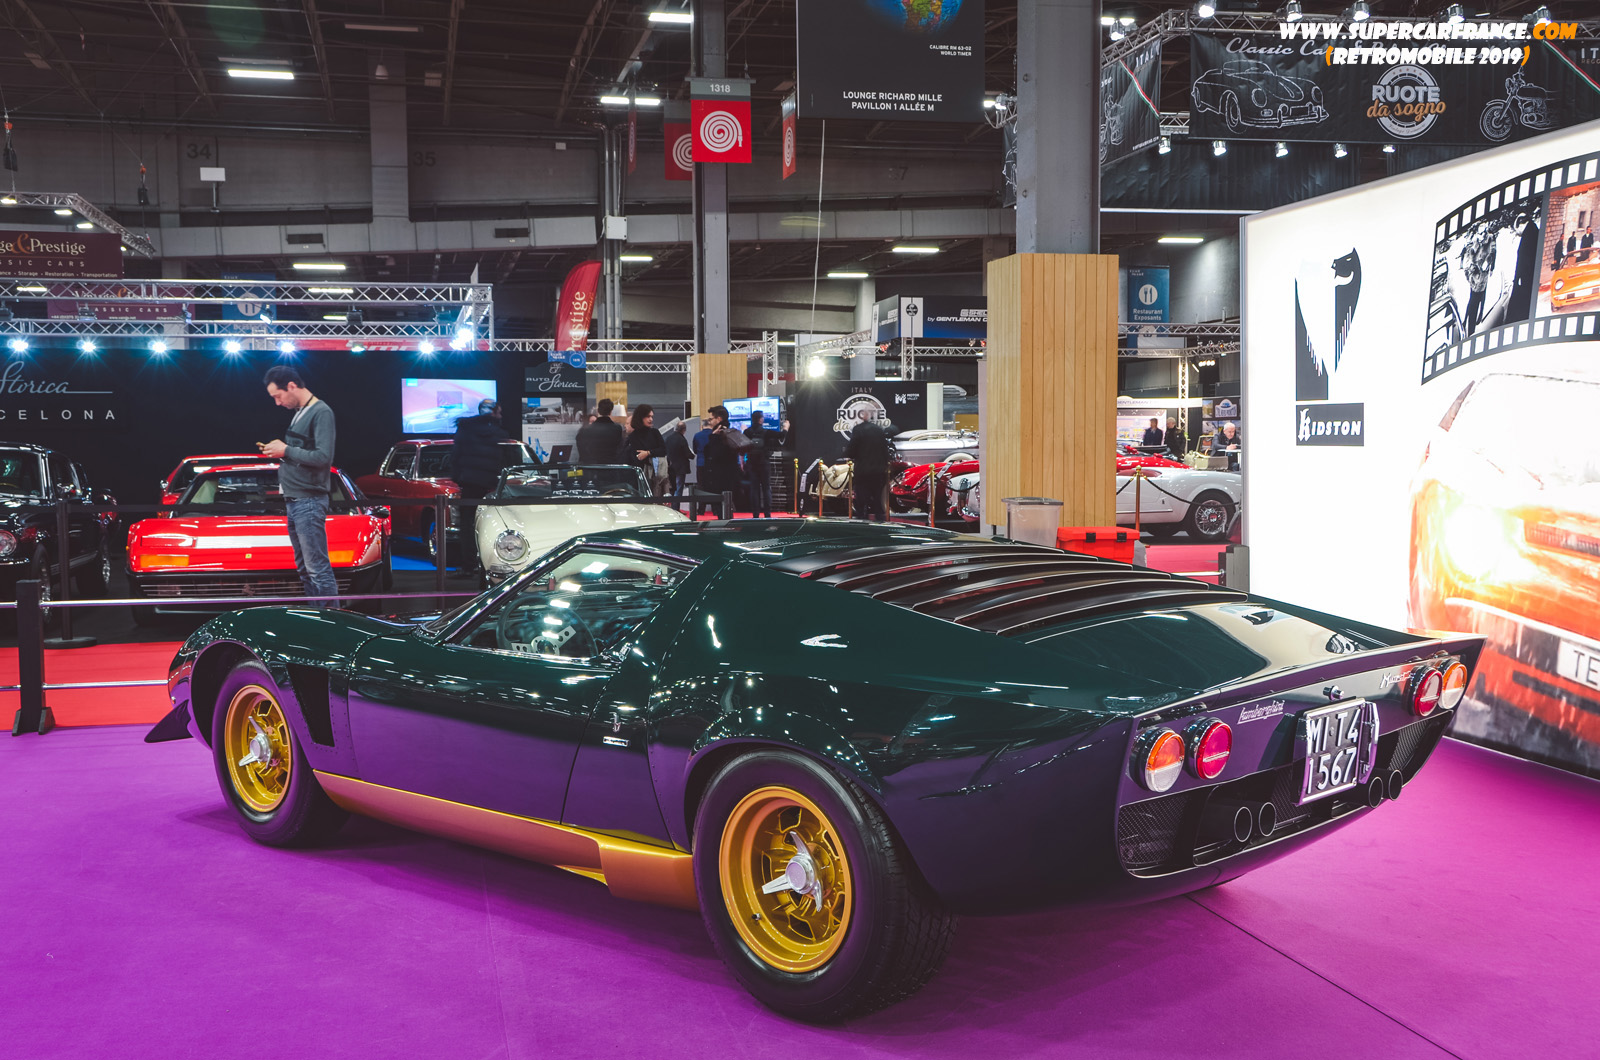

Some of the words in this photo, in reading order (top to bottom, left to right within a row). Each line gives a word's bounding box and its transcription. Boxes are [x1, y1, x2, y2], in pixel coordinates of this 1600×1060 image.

[1225, 37, 1295, 56] Classic
[709, 84, 731, 93] 1318
[843, 91, 877, 100] LOUNGE
[878, 92, 916, 101] RICHARD
[917, 94, 943, 102] MILLE
[1372, 85, 1440, 103] RUOTE
[851, 101, 892, 111] PAVILLON
[893, 103, 898, 111] 1
[899, 102, 926, 111] ALLÉE
[1367, 99, 1391, 118] da
[1394, 101, 1446, 122] sogno
[30, 238, 86, 256] Prestige
[1307, 746, 1358, 794] 1567
